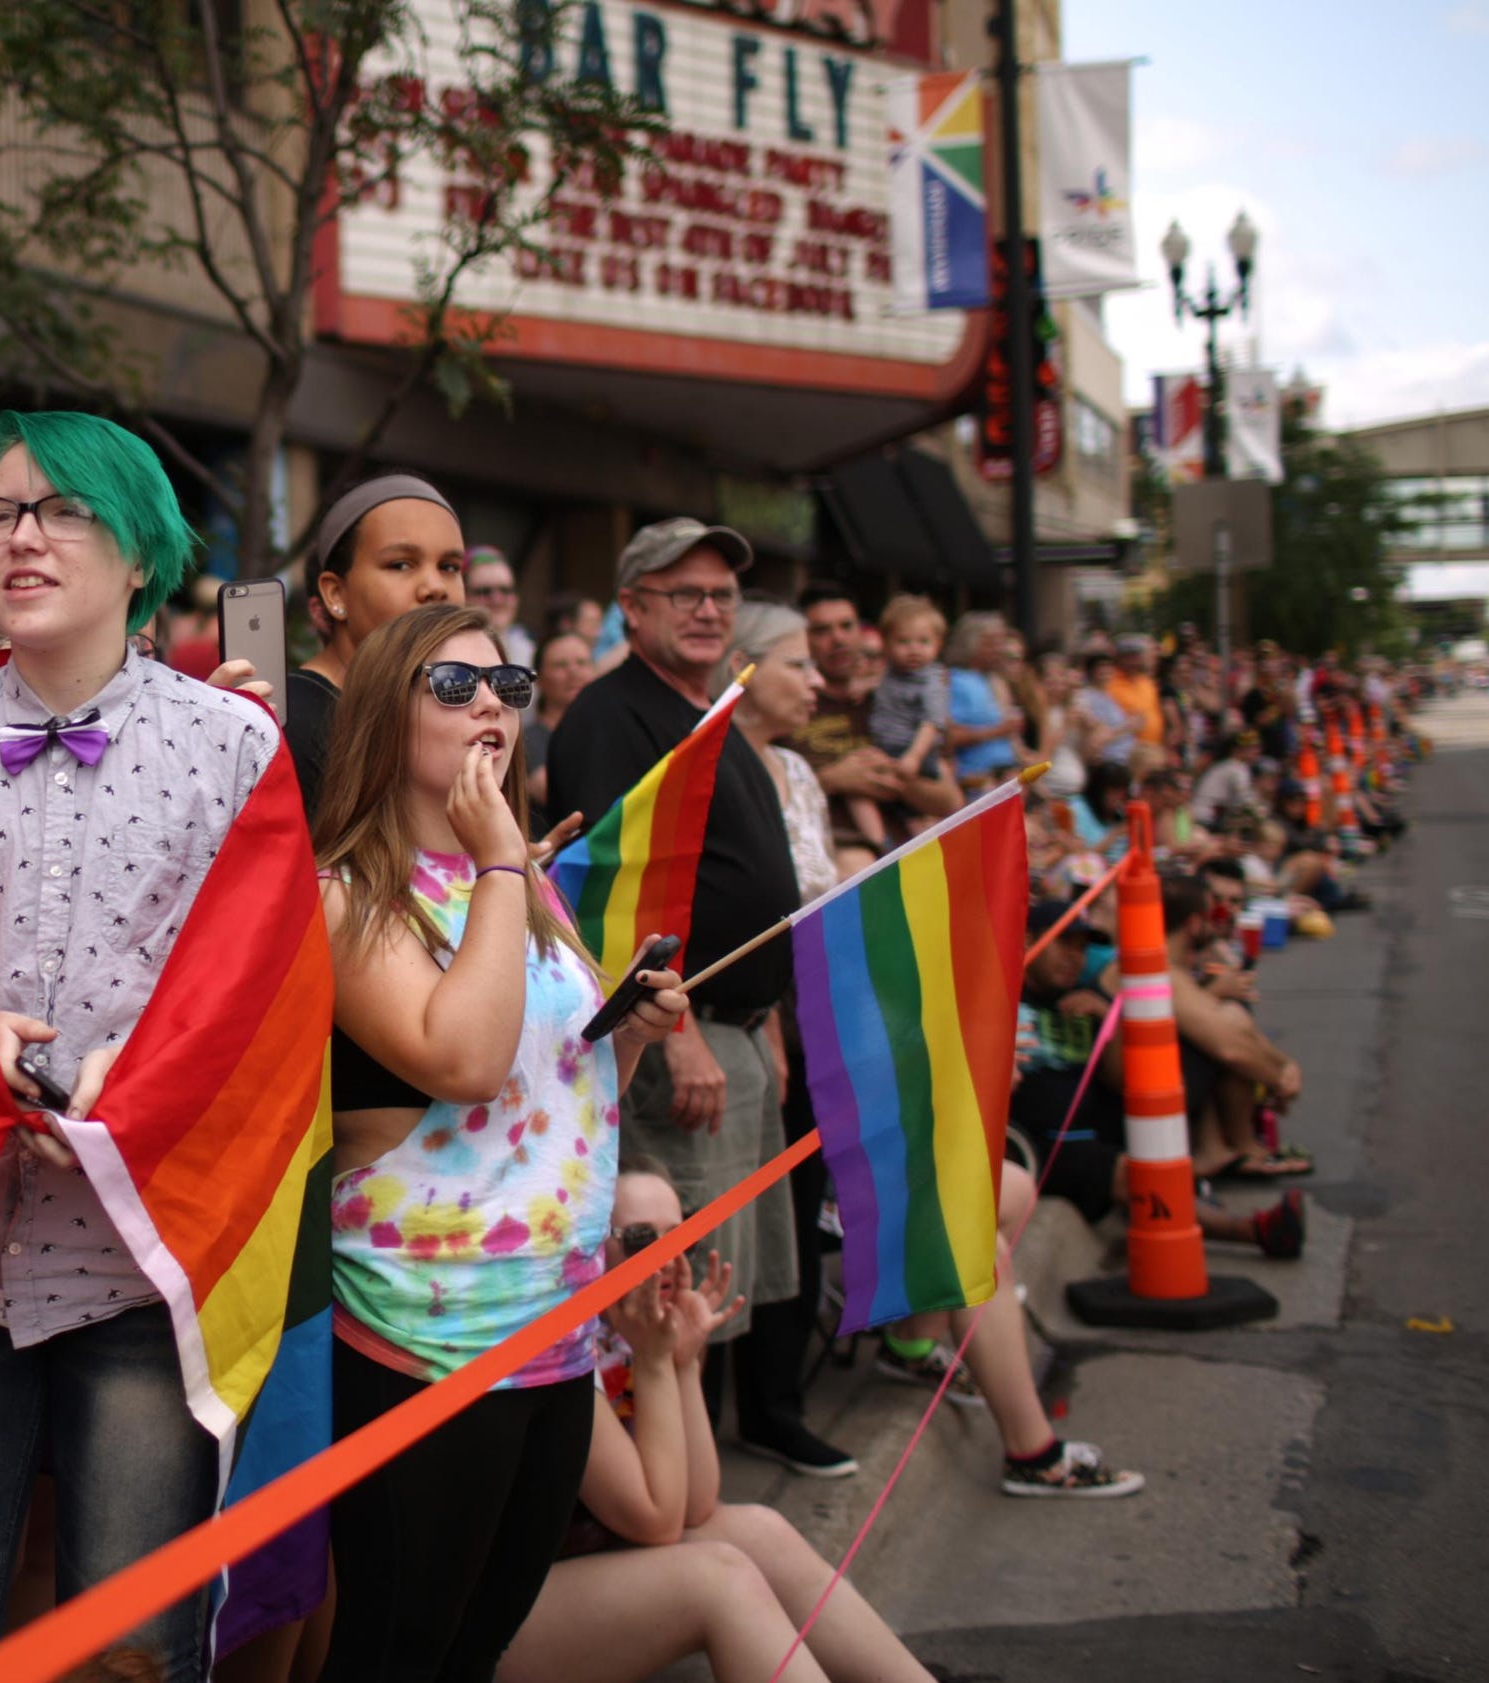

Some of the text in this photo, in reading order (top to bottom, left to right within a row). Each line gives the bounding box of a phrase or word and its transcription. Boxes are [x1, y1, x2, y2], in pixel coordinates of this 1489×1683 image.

[518, 0, 668, 117] BAR
[732, 34, 855, 148] FLY
[601, 253, 638, 293] US
[657, 263, 697, 299] ON
[712, 271, 854, 322] FACEBOOK
